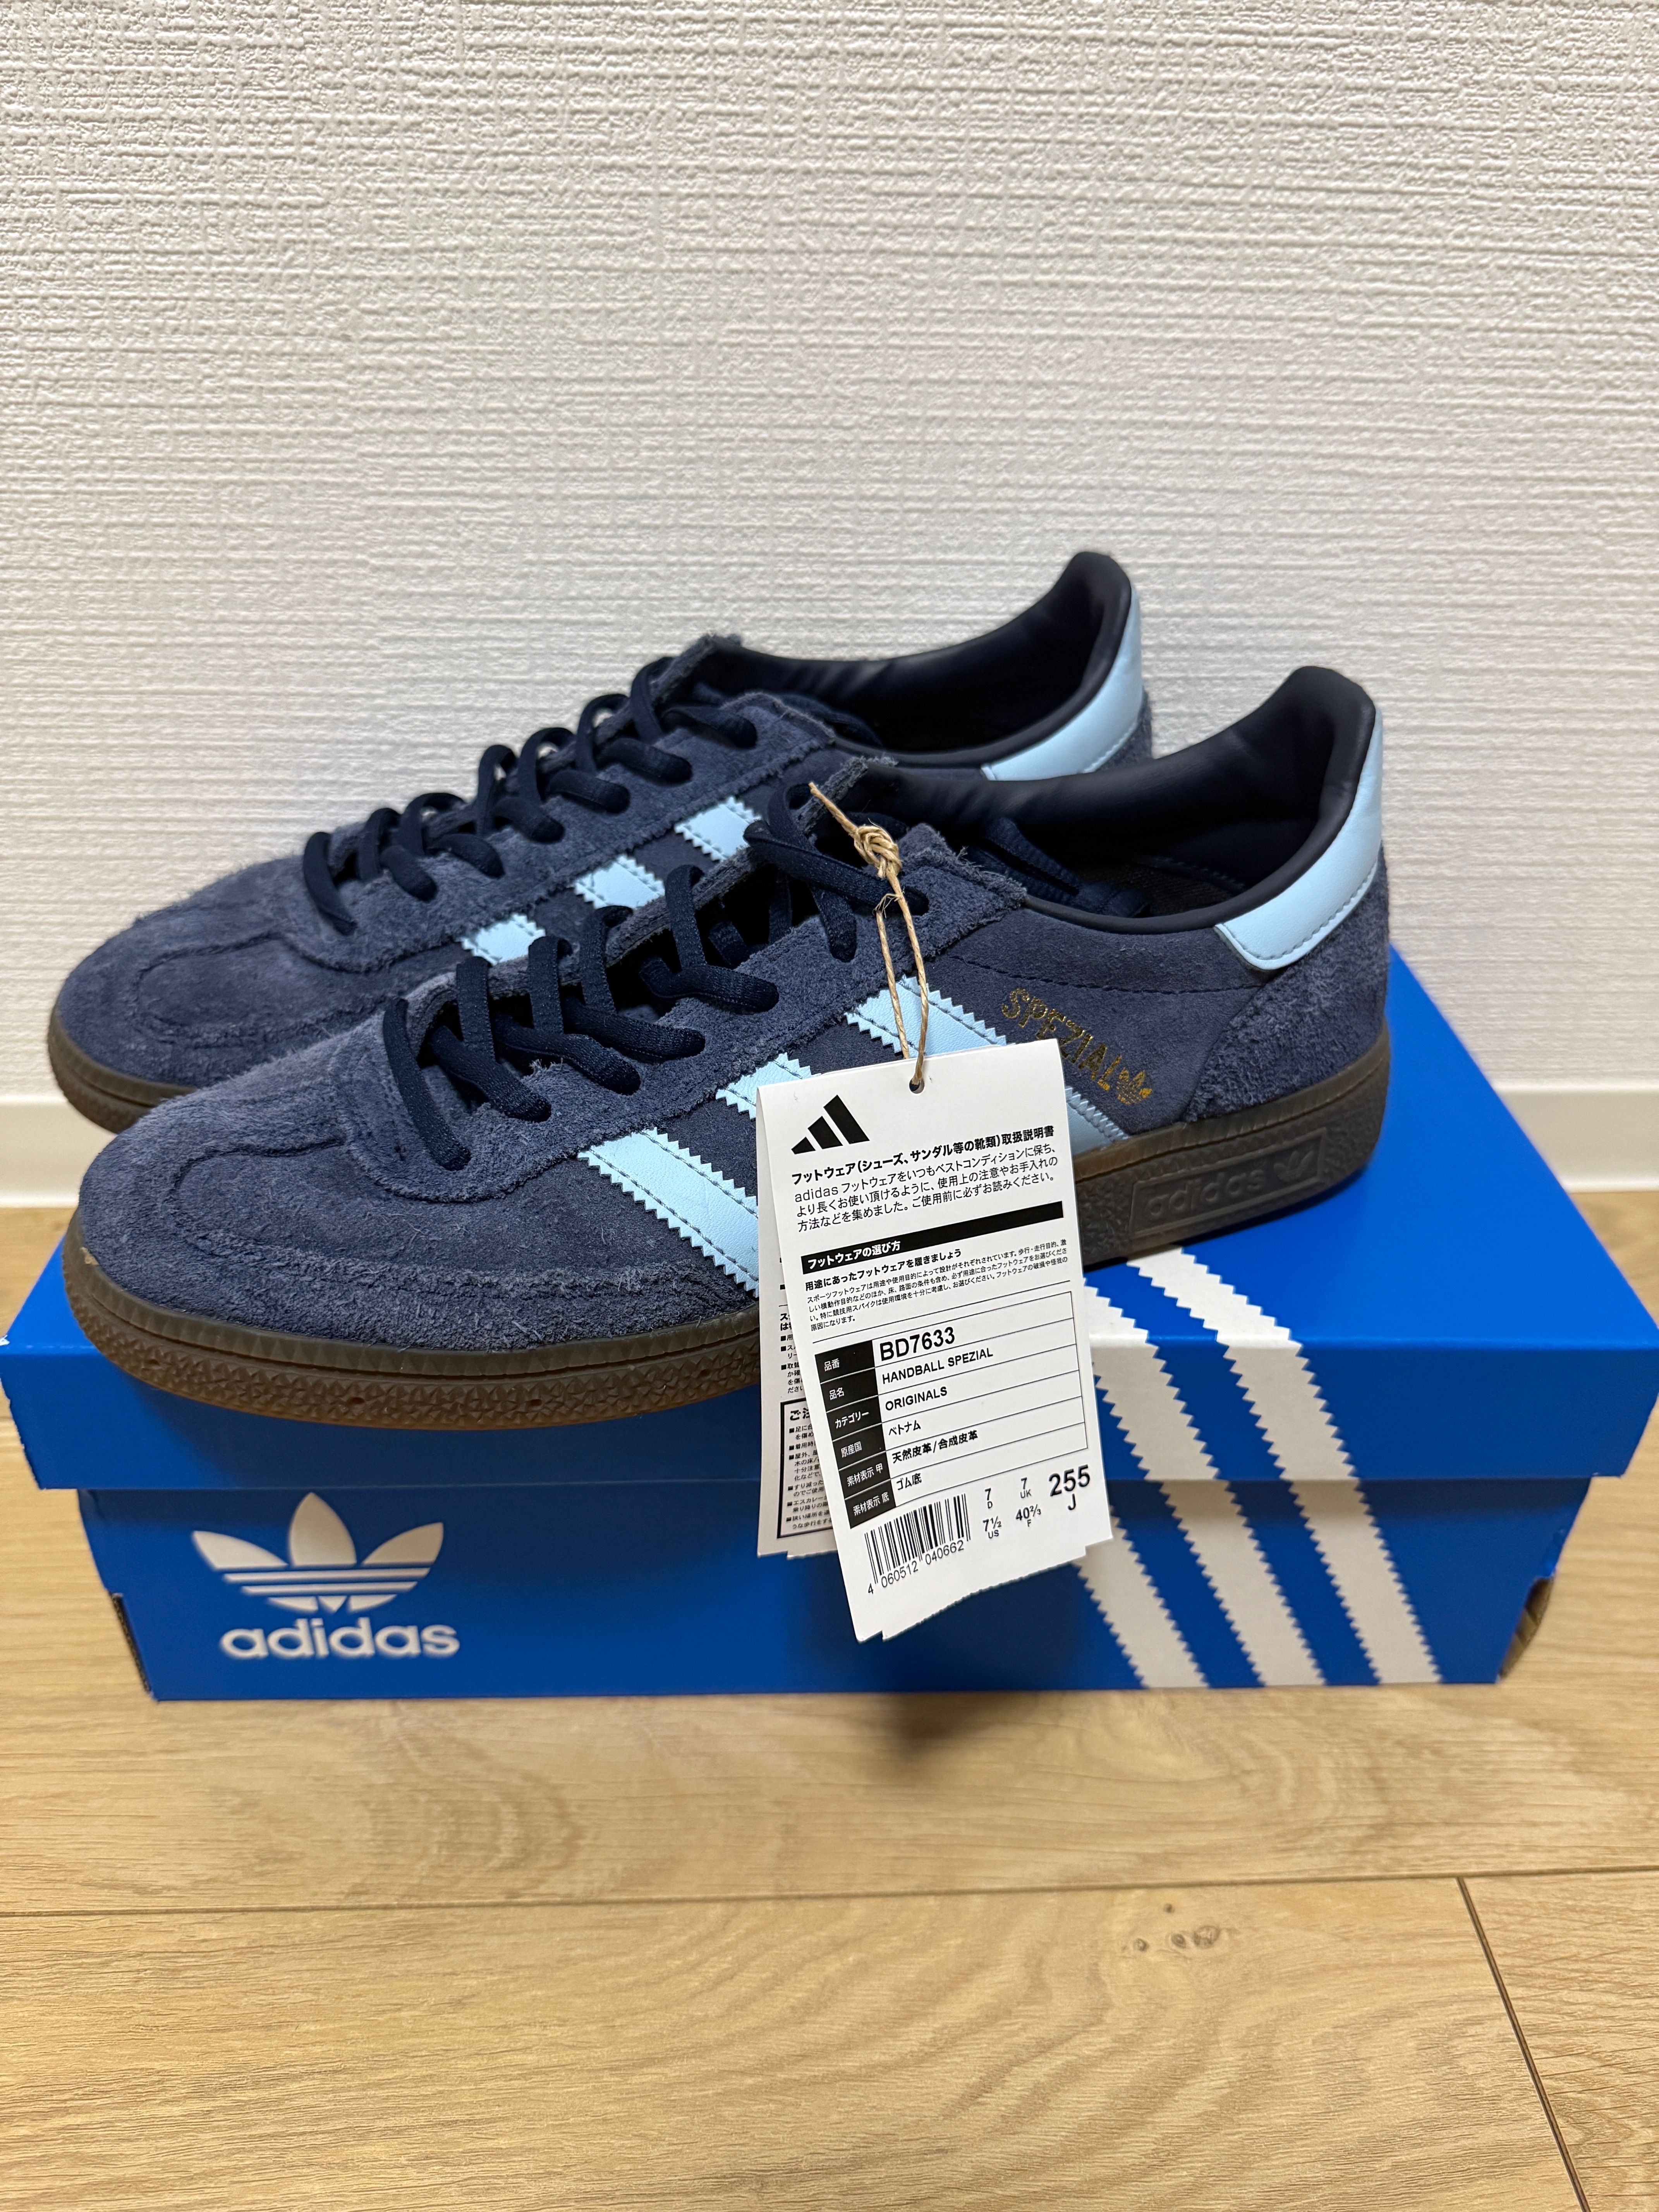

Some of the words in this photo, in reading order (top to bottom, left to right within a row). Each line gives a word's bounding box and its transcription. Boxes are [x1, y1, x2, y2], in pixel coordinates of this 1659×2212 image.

[1001, 988, 1122, 1091] SPEZIAL
[795, 1186, 838, 1202] adidas
[797, 1156, 1058, 1217] より長くお使い頂けるように、使用上の注意やお手入れの
[1145, 1169, 1265, 1217] adidas
[798, 1172, 1053, 1232] 方法などを集めました。ご使用前に必ずお読みください。
[808, 1241, 901, 1269] フットウェアの選び方
[805, 1249, 961, 1291] 用途にあったフットウェアを履きましょう
[811, 1316, 855, 1331] 原因になります。
[880, 1326, 955, 1361] BD7633
[824, 1358, 840, 1372] 品番
[883, 1360, 944, 1384] HANDBALL
[948, 1348, 993, 1367] SPEZIAL
[830, 1387, 844, 1400] 品名
[885, 1386, 948, 1410] ORIGINALS
[835, 1411, 869, 1429] カテゴリー
[888, 1420, 921, 1436] ベトナム
[841, 1441, 862, 1458] 原産国
[892, 1430, 978, 1464] 天然皮革/合成皮革
[847, 1467, 874, 1487] 素材表示
[876, 1463, 883, 1473] 甲
[896, 1473, 922, 1490] ゴム底
[984, 1487, 991, 1501] 7
[1021, 1477, 1027, 1489] 7
[1048, 1464, 1090, 1497] 255
[853, 1495, 880, 1516] 素材表示
[882, 1492, 890, 1503] 底
[987, 1501, 993, 1509] D
[1020, 1489, 1032, 1499] UK
[1067, 1494, 1075, 1511] J
[988, 1530, 999, 1539] US
[1027, 1519, 1032, 1527] F
[868, 1583, 874, 1594] 4
[881, 1560, 919, 1588] 060512
[925, 1540, 964, 1566] 040662
[220, 1617, 460, 1659] adidas
